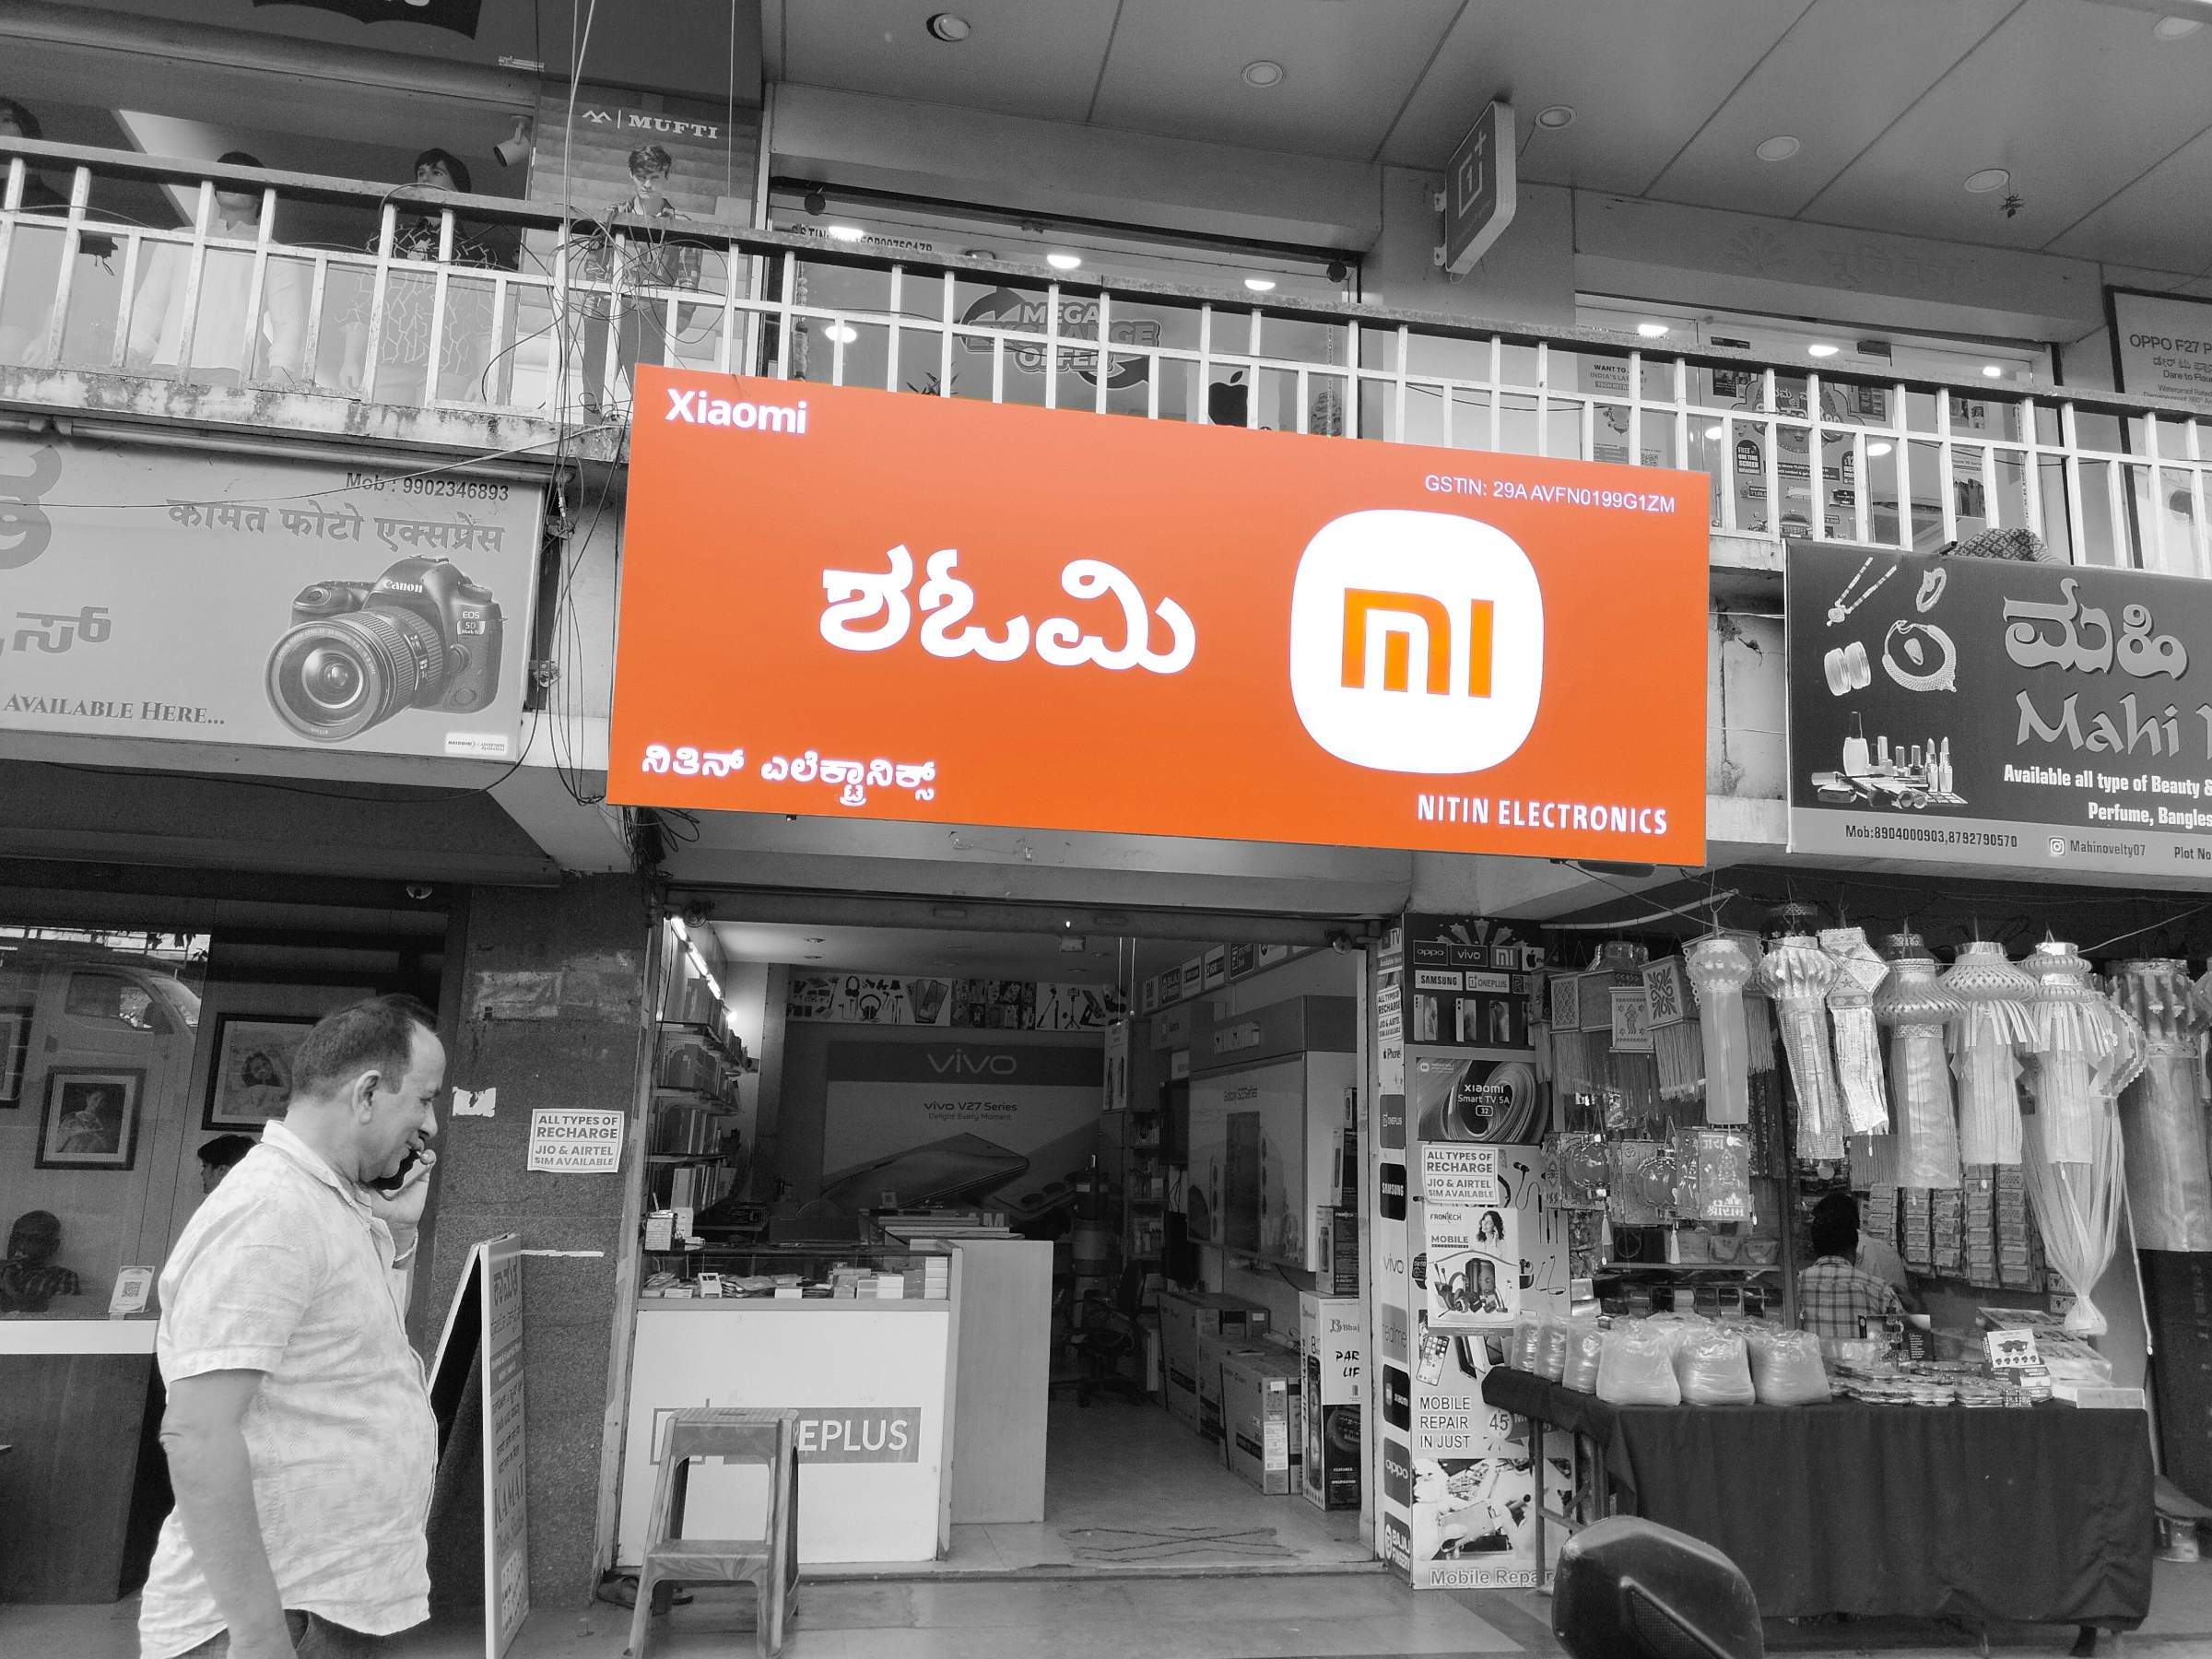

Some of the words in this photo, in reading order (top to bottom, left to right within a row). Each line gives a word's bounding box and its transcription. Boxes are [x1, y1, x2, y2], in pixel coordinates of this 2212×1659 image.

[629, 114, 717, 139] MUFTI
[2130, 335, 2172, 350] OPPO
[2175, 339, 2199, 353] F27
[1594, 363, 1616, 371] WANT
[665, 388, 807, 435] Xiaomi
[346, 472, 384, 491] Mob
[403, 477, 509, 500] 9902346893
[1425, 474, 1488, 496] GSTIN:
[166, 499, 269, 533] कामत
[278, 499, 365, 542] फोटो
[383, 580, 423, 593] Canon
[818, 544, 1196, 675] ಶಓಮಿ
[2016, 690, 2182, 758] Mahi
[641, 745, 745, 777] ನಿತಿನ್
[2004, 764, 2071, 786] Available
[2076, 771, 2093, 788] all
[2097, 772, 2129, 793] type
[2133, 774, 2148, 792] of
[2151, 775, 2200, 799] Beauty
[1417, 794, 1488, 824] NITIN
[1498, 799, 1667, 834] ELECTRONICS
[2088, 802, 2154, 826] Perfume,
[2070, 840, 2146, 858] Mahinovelty07
[2174, 846, 2194, 859] Plot
[1457, 948, 1481, 959] vivo
[1420, 975, 1457, 986] SAMSUNG
[1477, 979, 1507, 989] ONEPLUS
[927, 1048, 1018, 1075] vivo
[924, 1100, 955, 1111] vivo
[959, 1101, 982, 1111] V27
[984, 1102, 1018, 1112] Series
[1457, 1094, 1482, 1104] Smart
[1485, 1095, 1497, 1104] TV
[1499, 1096, 1510, 1105] 5A
[538, 1115, 559, 1124] ALL
[562, 1116, 599, 1125] TYPES
[602, 1117, 618, 1125] OF
[536, 1127, 618, 1139] RECHARGE
[535, 1146, 556, 1154] JIO
[559, 1146, 568, 1155] &
[571, 1147, 613, 1156] AIRTEL
[1427, 1152, 1443, 1160] ALL
[1445, 1152, 1477, 1161] TYPES
[1478, 1153, 1492, 1161] OF
[535, 1157, 554, 1165] SIM
[556, 1158, 615, 1166] AVAILABLE
[1427, 1161, 1493, 1173] RECHARGE
[1382, 1182, 1405, 1196] SAMSUNG
[1428, 1178, 1443, 1187] JIO
[1446, 1179, 1454, 1187] &
[1456, 1180, 1491, 1189] AIRTEL
[1428, 1189, 1443, 1197] SIM
[1445, 1190, 1494, 1198] AVAILABLE
[1431, 1235, 1468, 1243] MOBILE
[1420, 1397, 1471, 1410] MOBILE
[1420, 1416, 1468, 1429] REPAIR
[1489, 1414, 1509, 1430] 45
[1420, 1436, 1434, 1448] IN
[1437, 1436, 1470, 1448] JUST
[1386, 1460, 1408, 1478] oppo
[1431, 1570, 1489, 1585] Mobile
